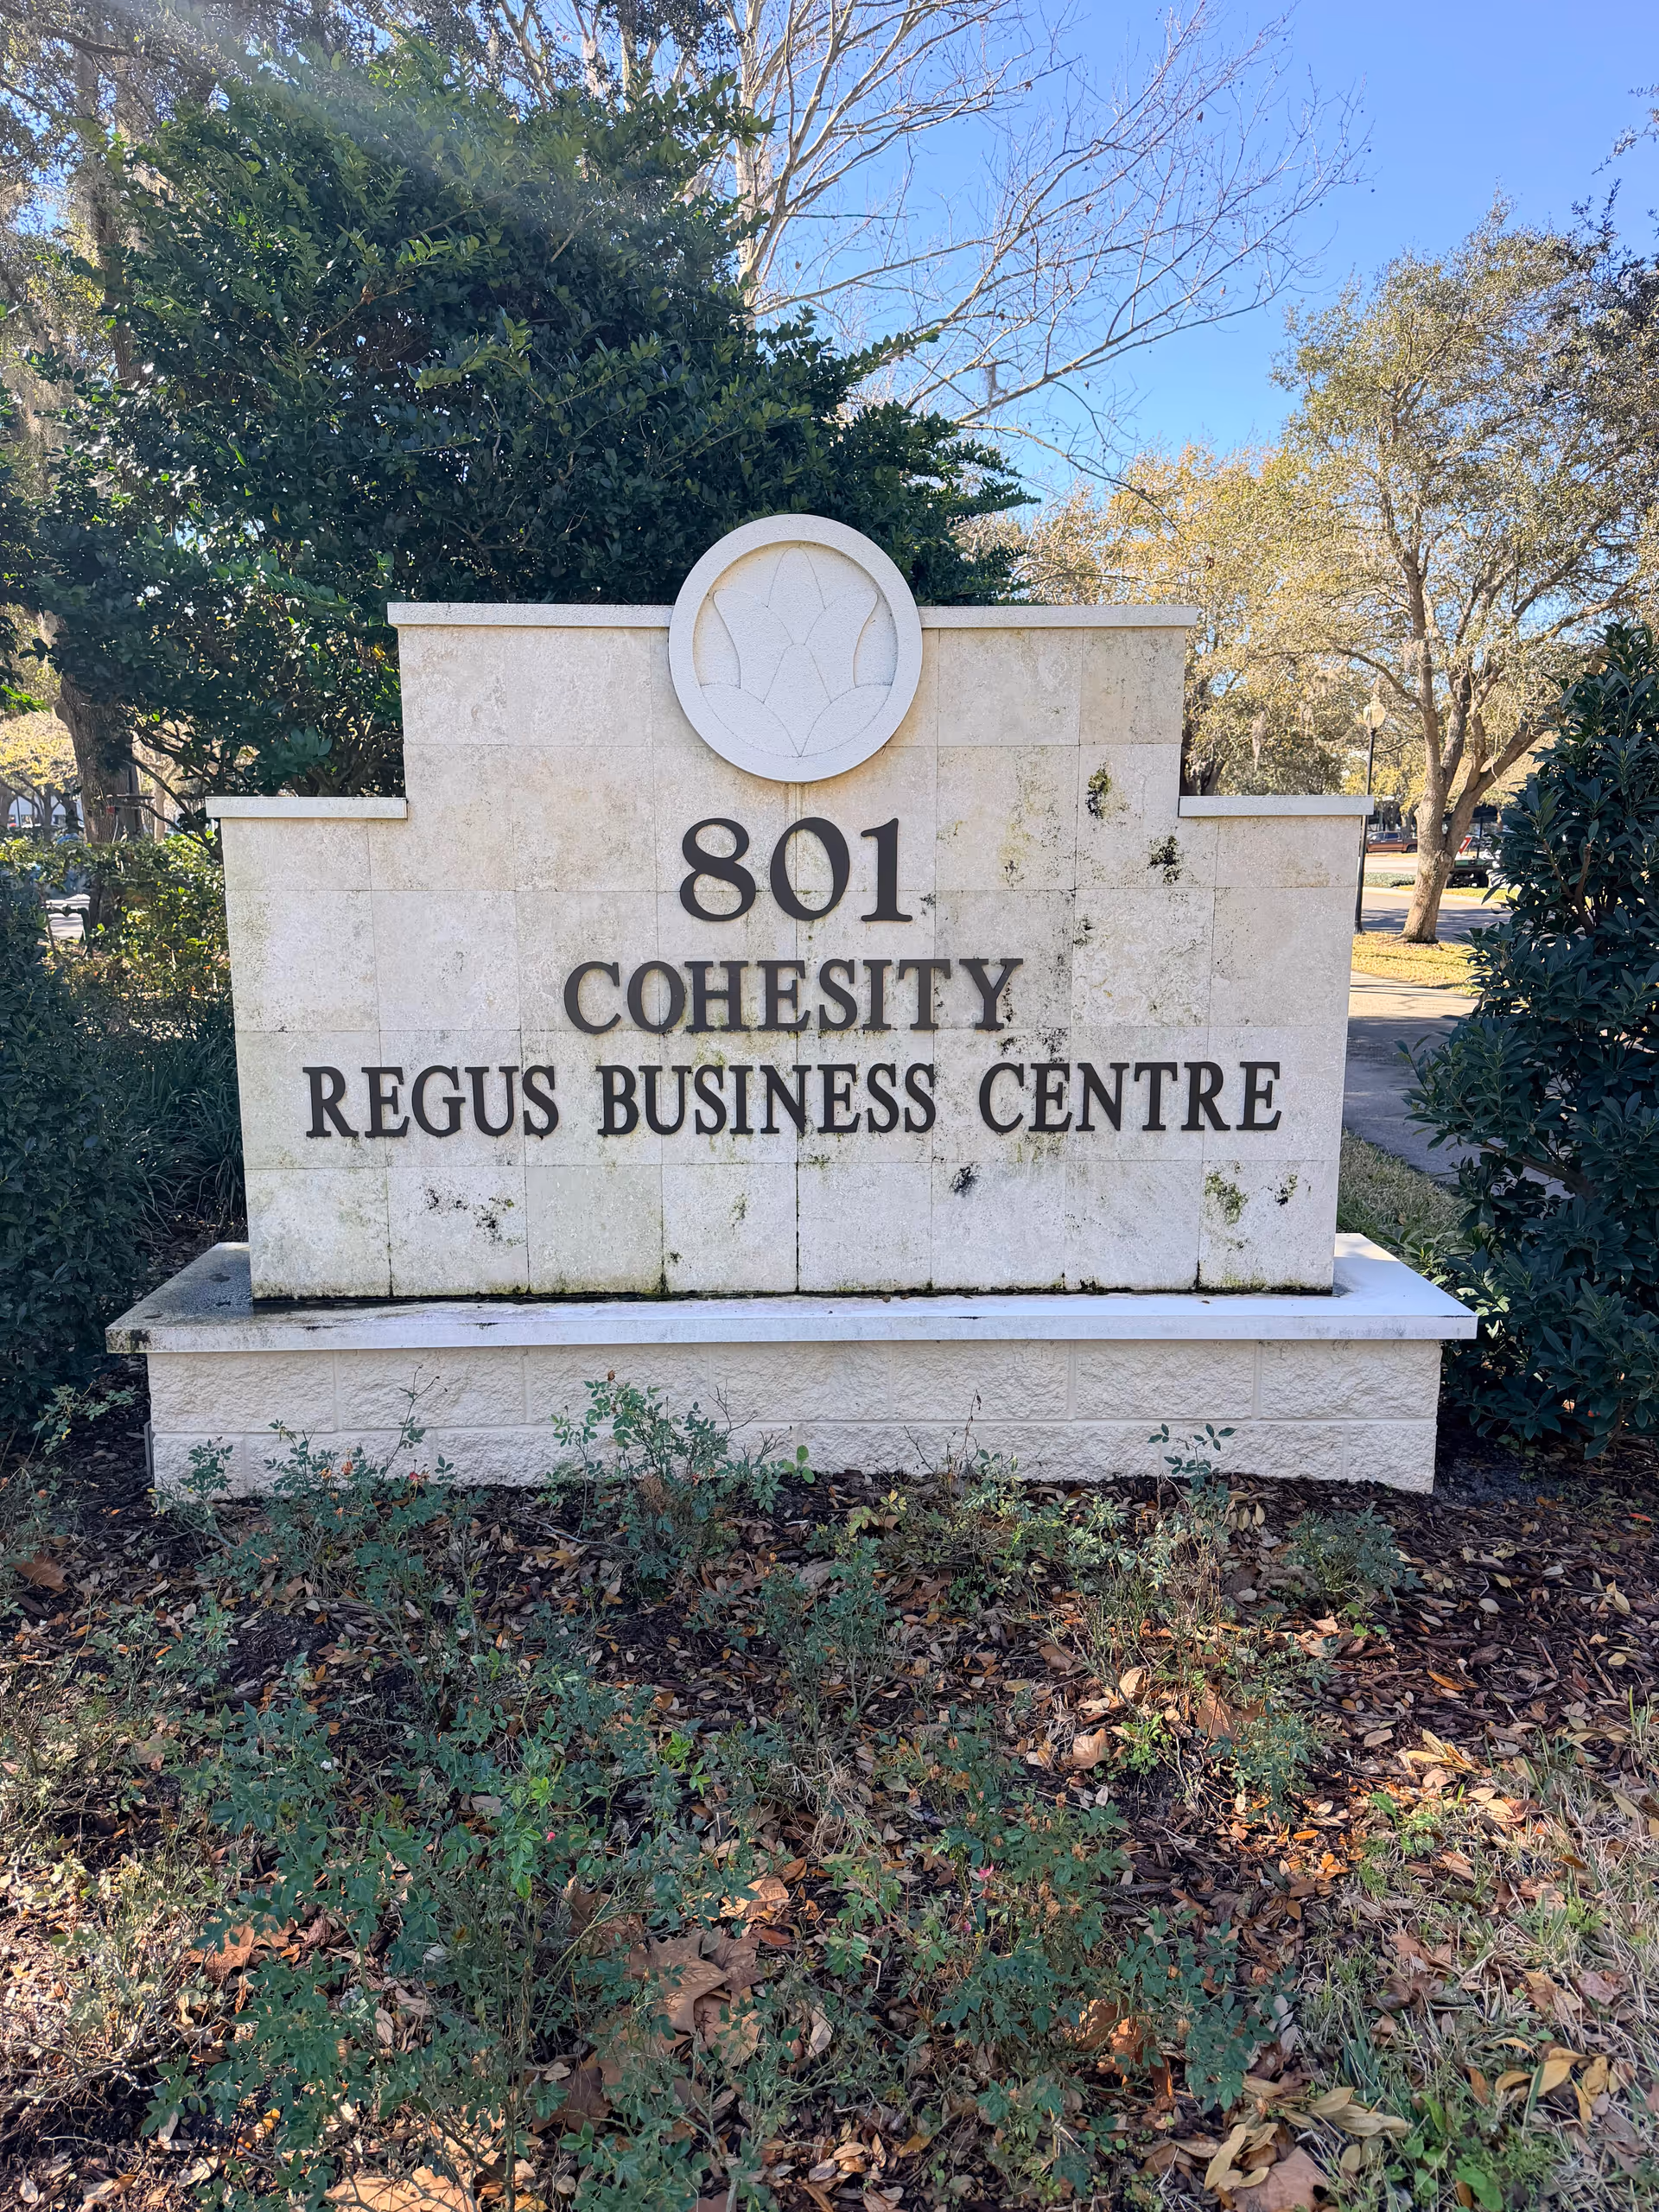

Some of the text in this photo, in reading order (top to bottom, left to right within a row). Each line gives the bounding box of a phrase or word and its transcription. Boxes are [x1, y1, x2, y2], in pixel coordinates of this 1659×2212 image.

[679, 817, 913, 922] 801
[564, 957, 1023, 1035] COHESITY
[302, 1062, 1281, 1139] REGUS BUSINESS CENTRE
